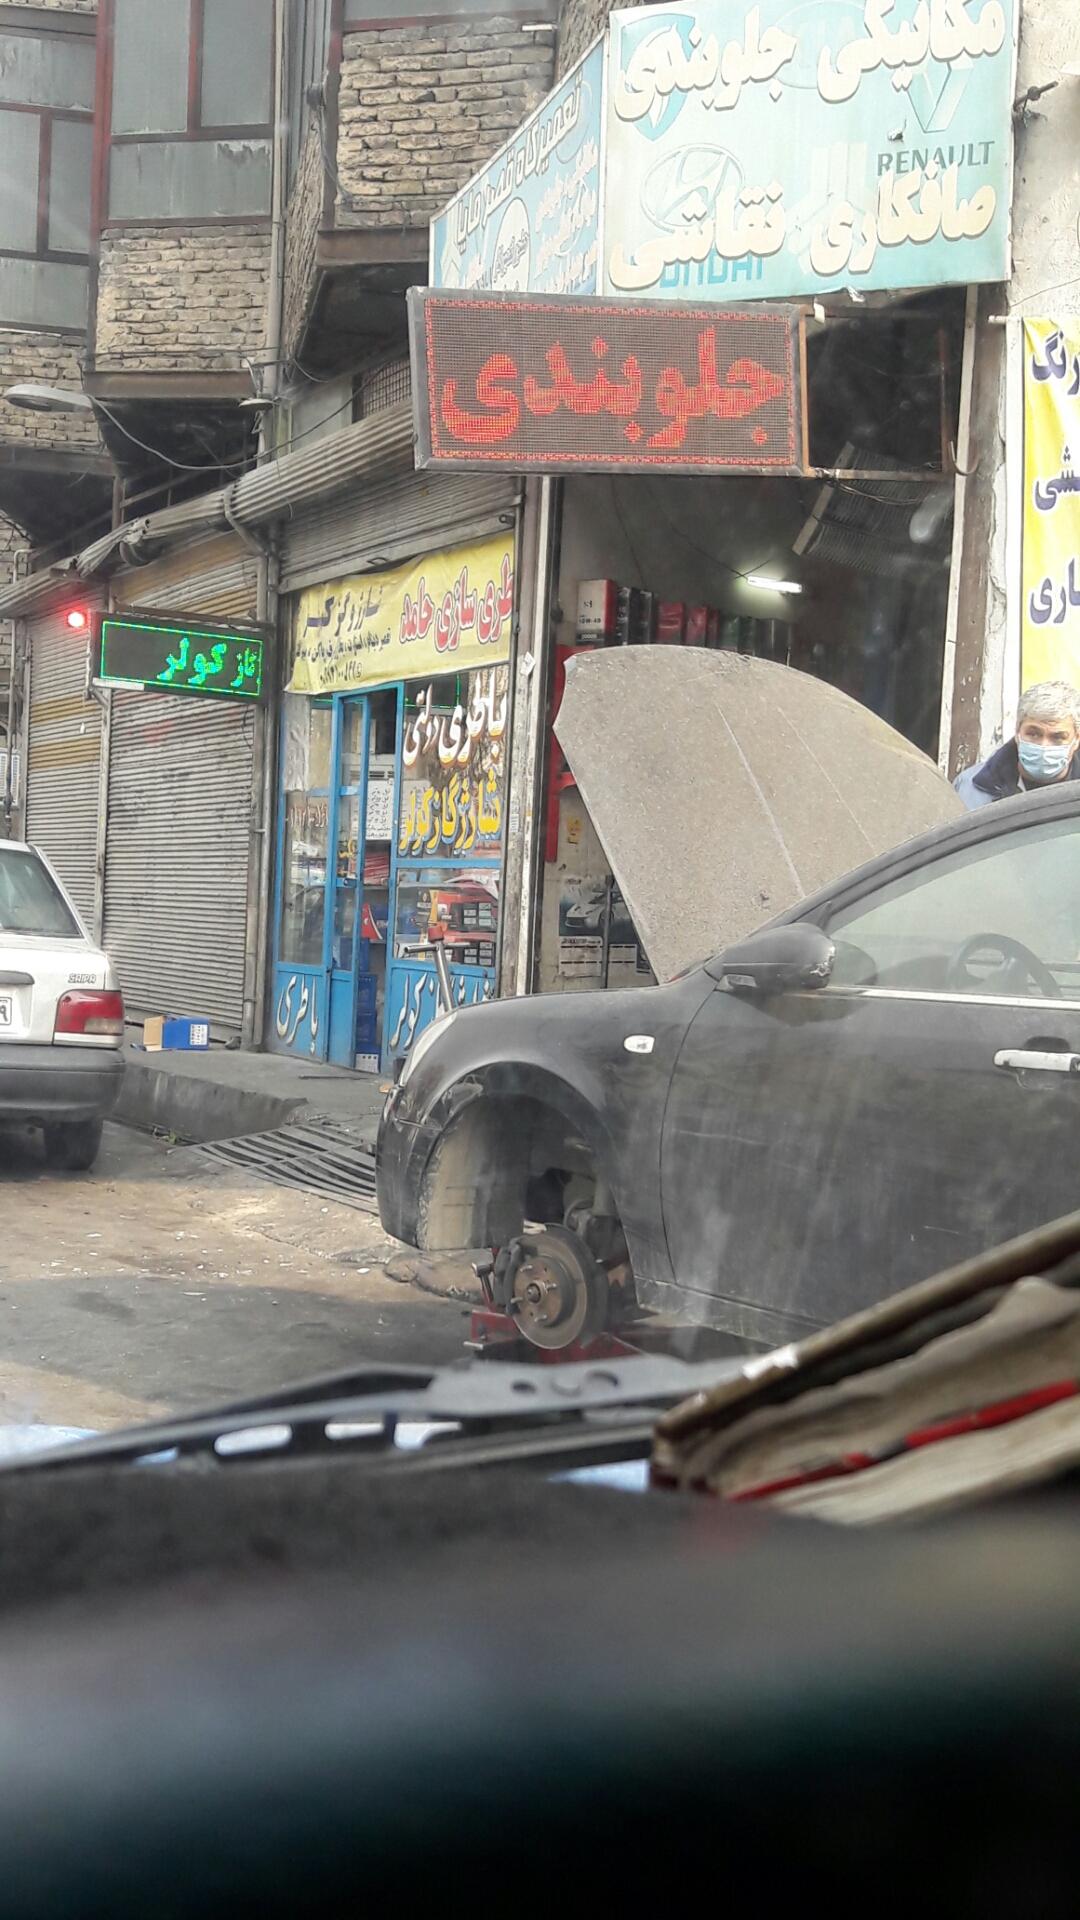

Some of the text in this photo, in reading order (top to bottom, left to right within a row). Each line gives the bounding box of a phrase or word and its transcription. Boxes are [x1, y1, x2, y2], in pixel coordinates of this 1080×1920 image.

[815, 0, 1007, 103] مکانیکی
[877, 140, 996, 177] RENAULT
[809, 160, 997, 276] صافکاری
[399, 576, 436, 644] حامد
[434, 566, 478, 653] سازی
[156, 637, 228, 686] کولر
[439, 665, 508, 767] باطری
[398, 786, 434, 855] کولر
[426, 772, 459, 852] گاز
[454, 768, 501, 852] شارژ
[67, 973, 97, 984] SAIPA
[276, 974, 318, 1055] باطری
